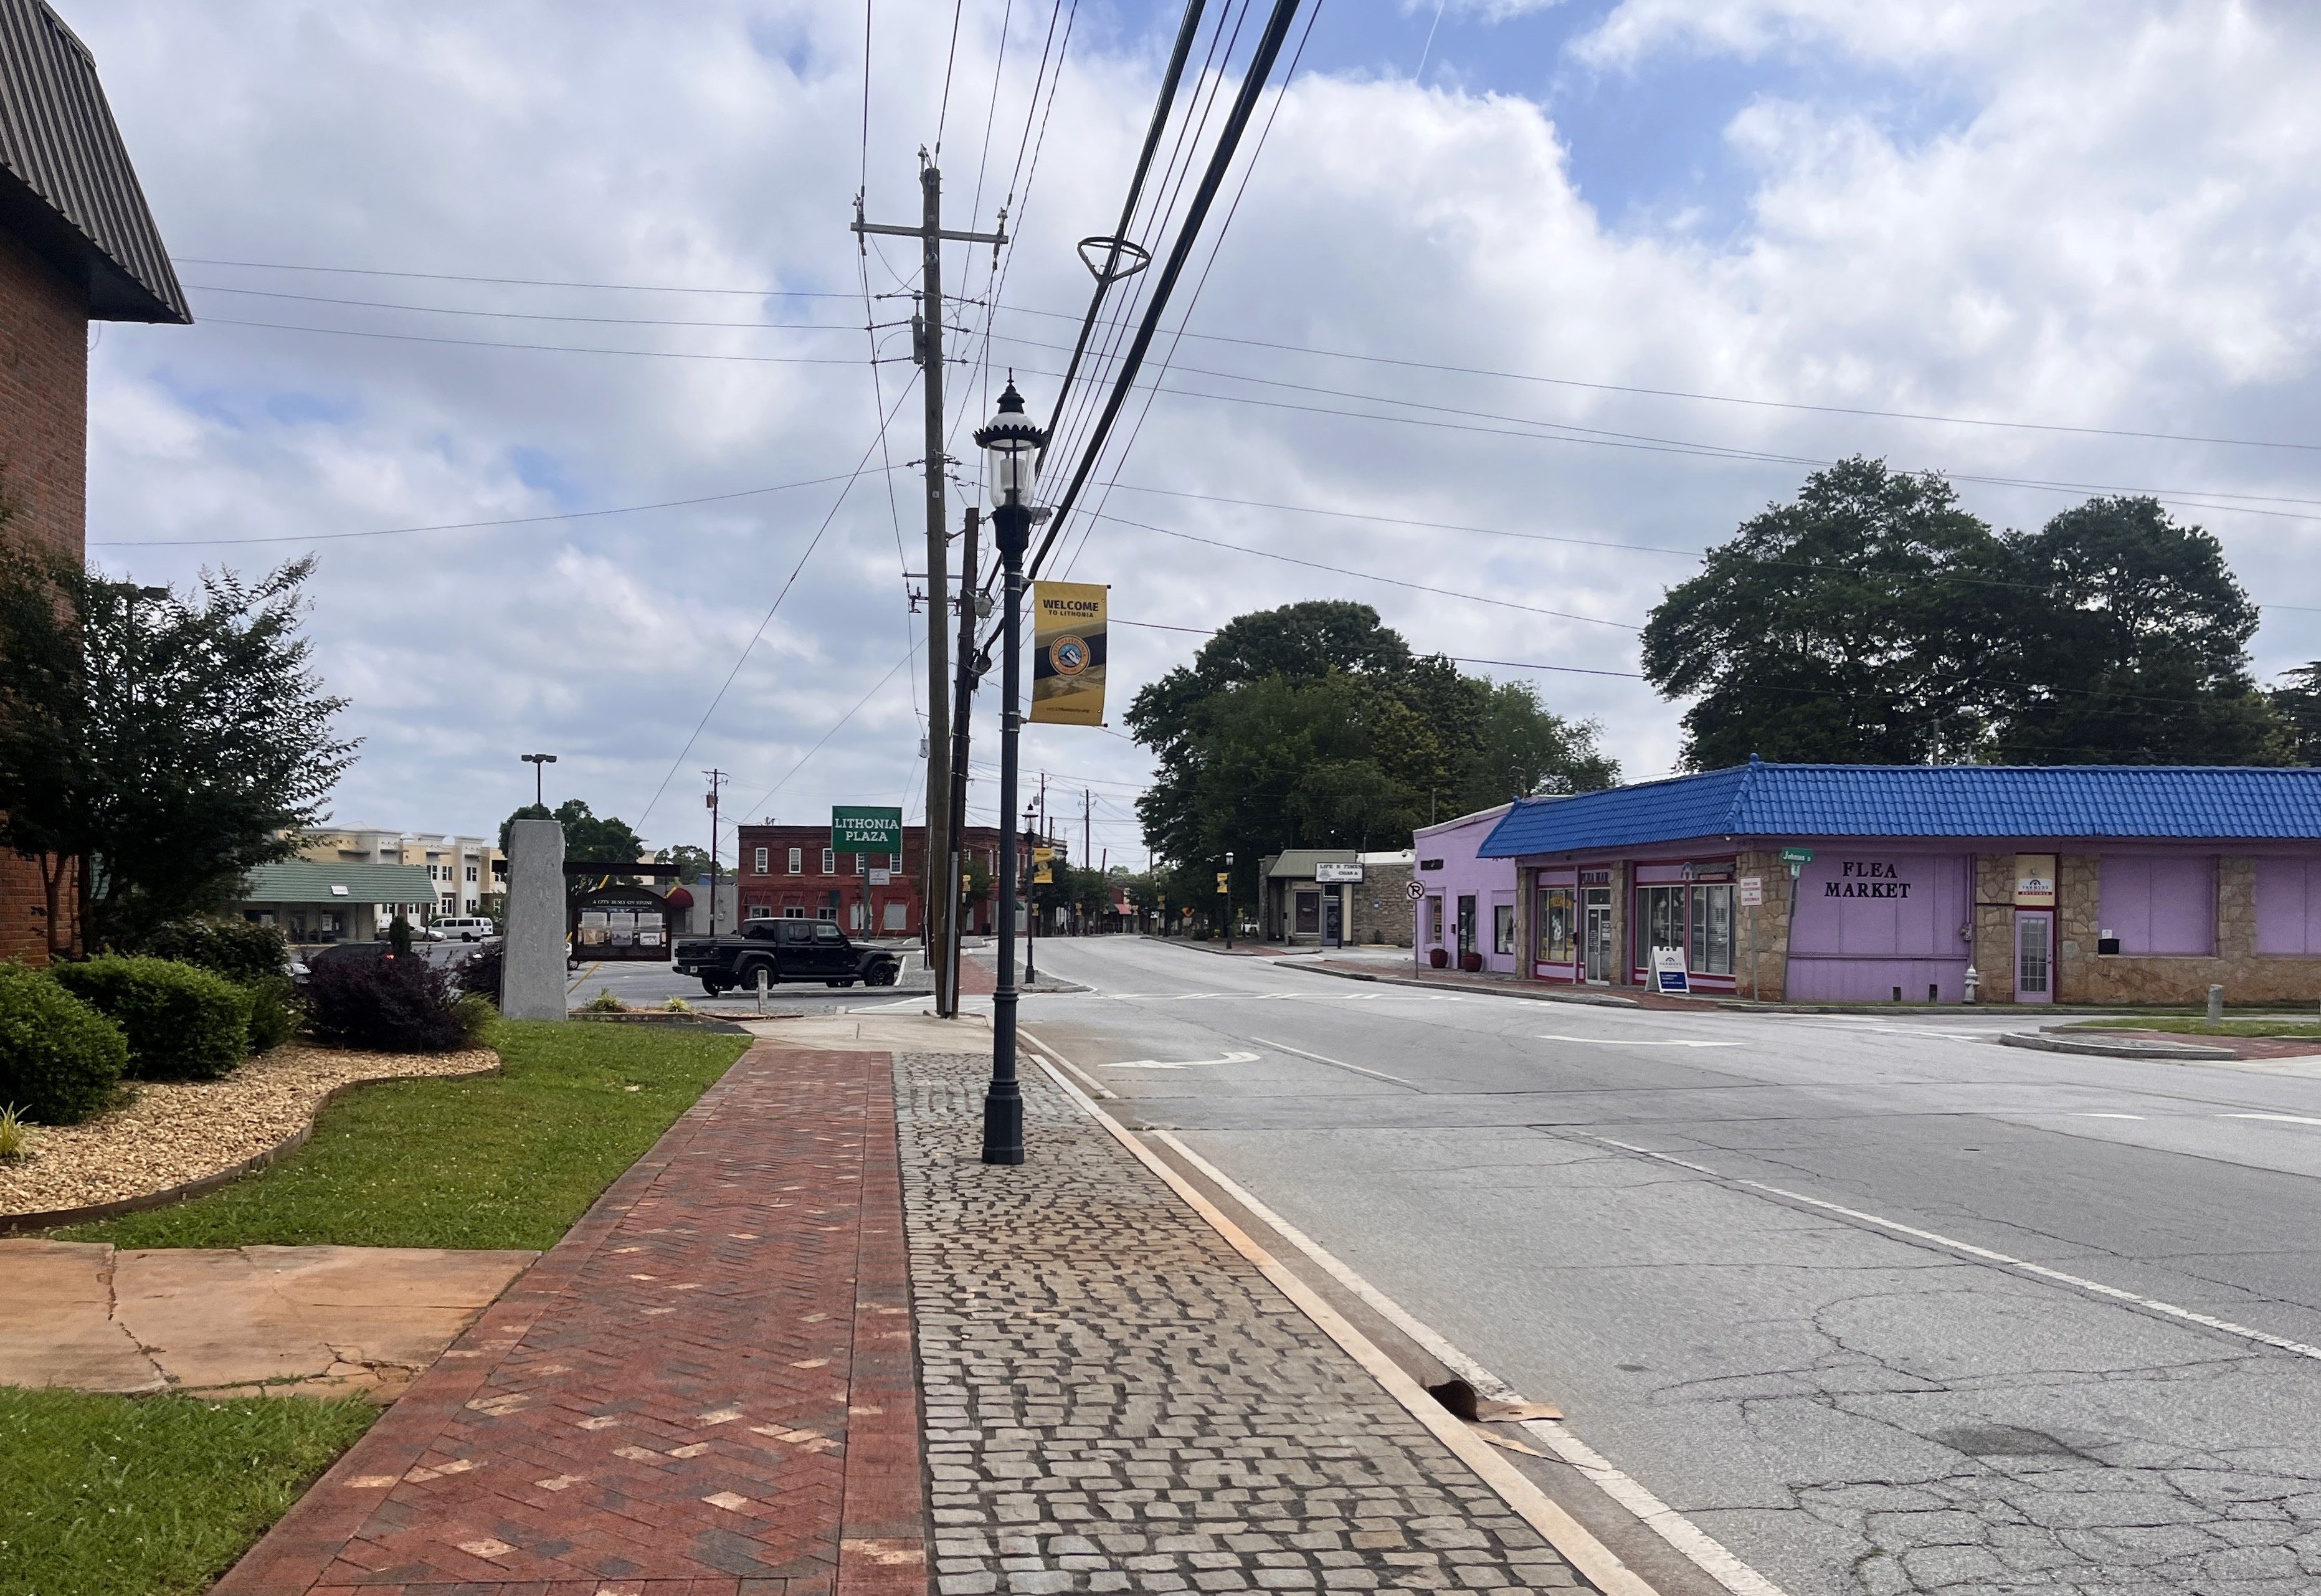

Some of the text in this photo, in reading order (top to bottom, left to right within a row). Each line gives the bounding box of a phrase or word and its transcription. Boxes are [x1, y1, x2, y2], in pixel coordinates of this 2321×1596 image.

[1043, 599, 1099, 611] WELCOME
[835, 818, 899, 829] LITHONIA
[845, 831, 888, 842] PLAZA
[1843, 862, 1897, 878] FLEA
[1825, 882, 1911, 898] MARKET
